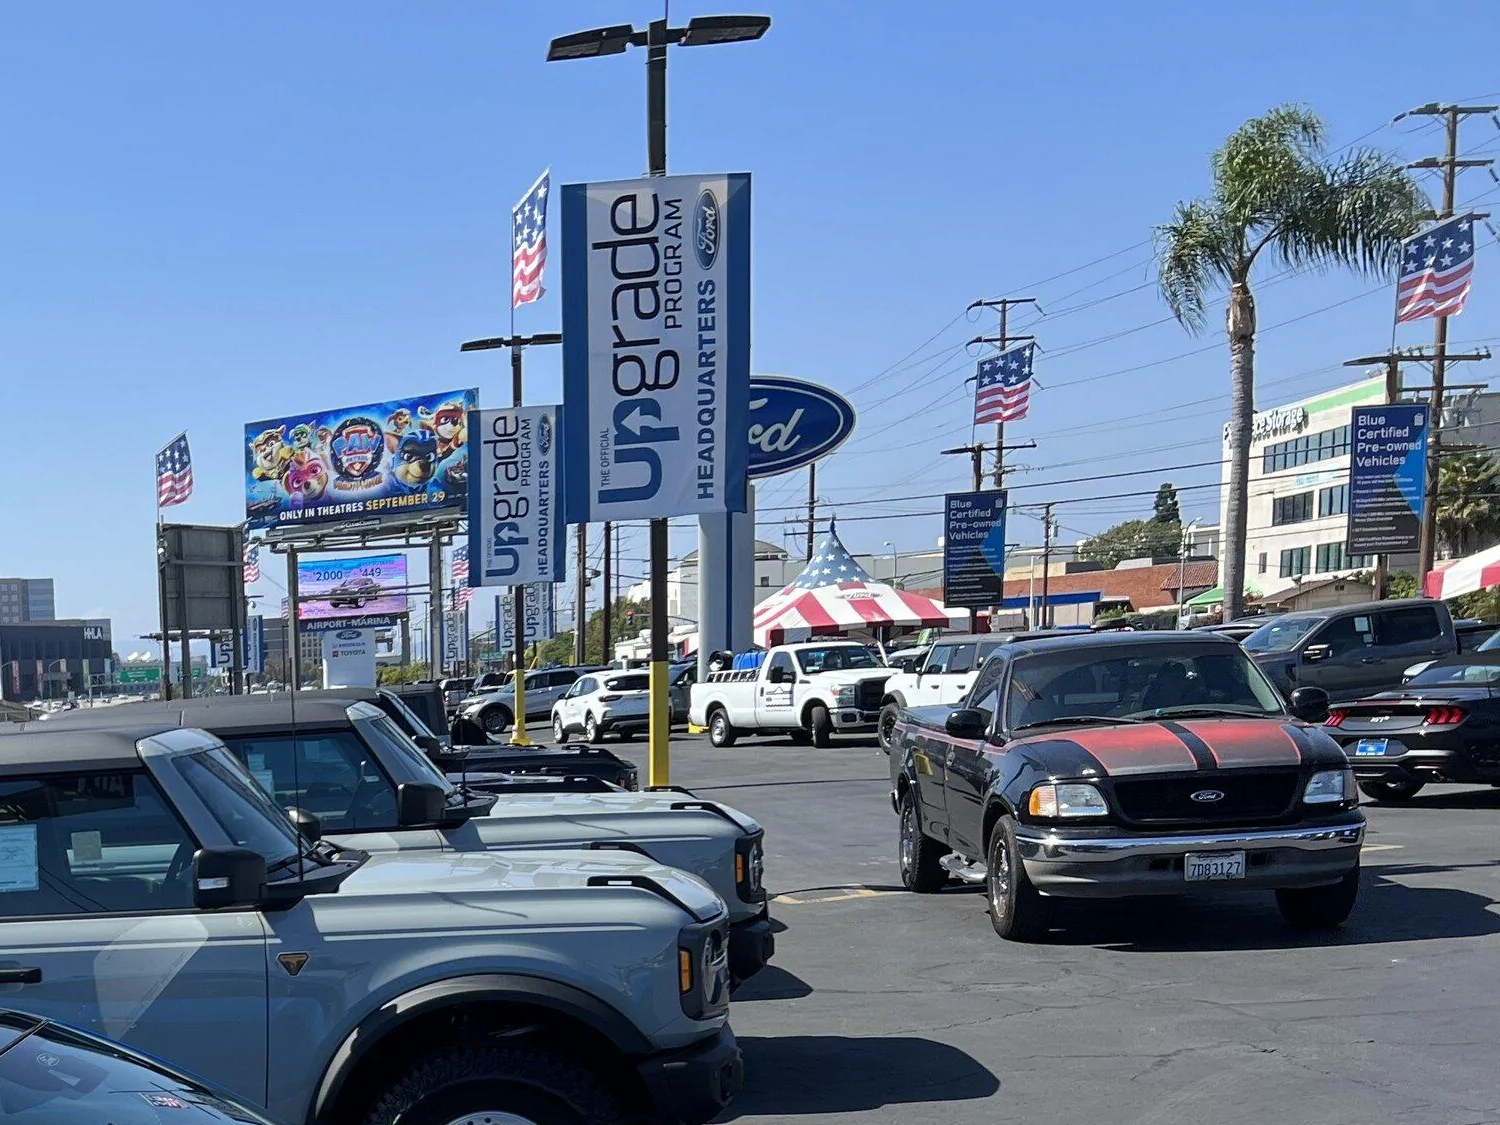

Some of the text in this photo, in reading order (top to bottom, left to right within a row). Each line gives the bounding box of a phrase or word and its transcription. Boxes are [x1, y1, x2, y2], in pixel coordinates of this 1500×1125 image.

[697, 206, 716, 254] Ford
[664, 198, 682, 329] PROGRAM
[697, 279, 716, 499] HEADQUARTERS
[1266, 407, 1304, 432] Storage
[1358, 415, 1386, 426] Blue
[1358, 426, 1409, 440] Certified
[521, 418, 532, 487] PROGRAM
[1357, 439, 1422, 453] Pre-owned
[600, 428, 610, 487] THE OFFICIAL
[1356, 455, 1406, 467] Vehicles
[279, 491, 446, 521] ONLY IN THEATRES SEPTEMBER 29
[950, 500, 972, 509] Blue
[538, 460, 549, 576] HEADQUARTERS
[950, 508, 991, 519] Certified
[949, 519, 1001, 529] Pre-owned
[949, 531, 989, 540] Vehicles
[307, 616, 391, 630] AIRPORT-MARINA
